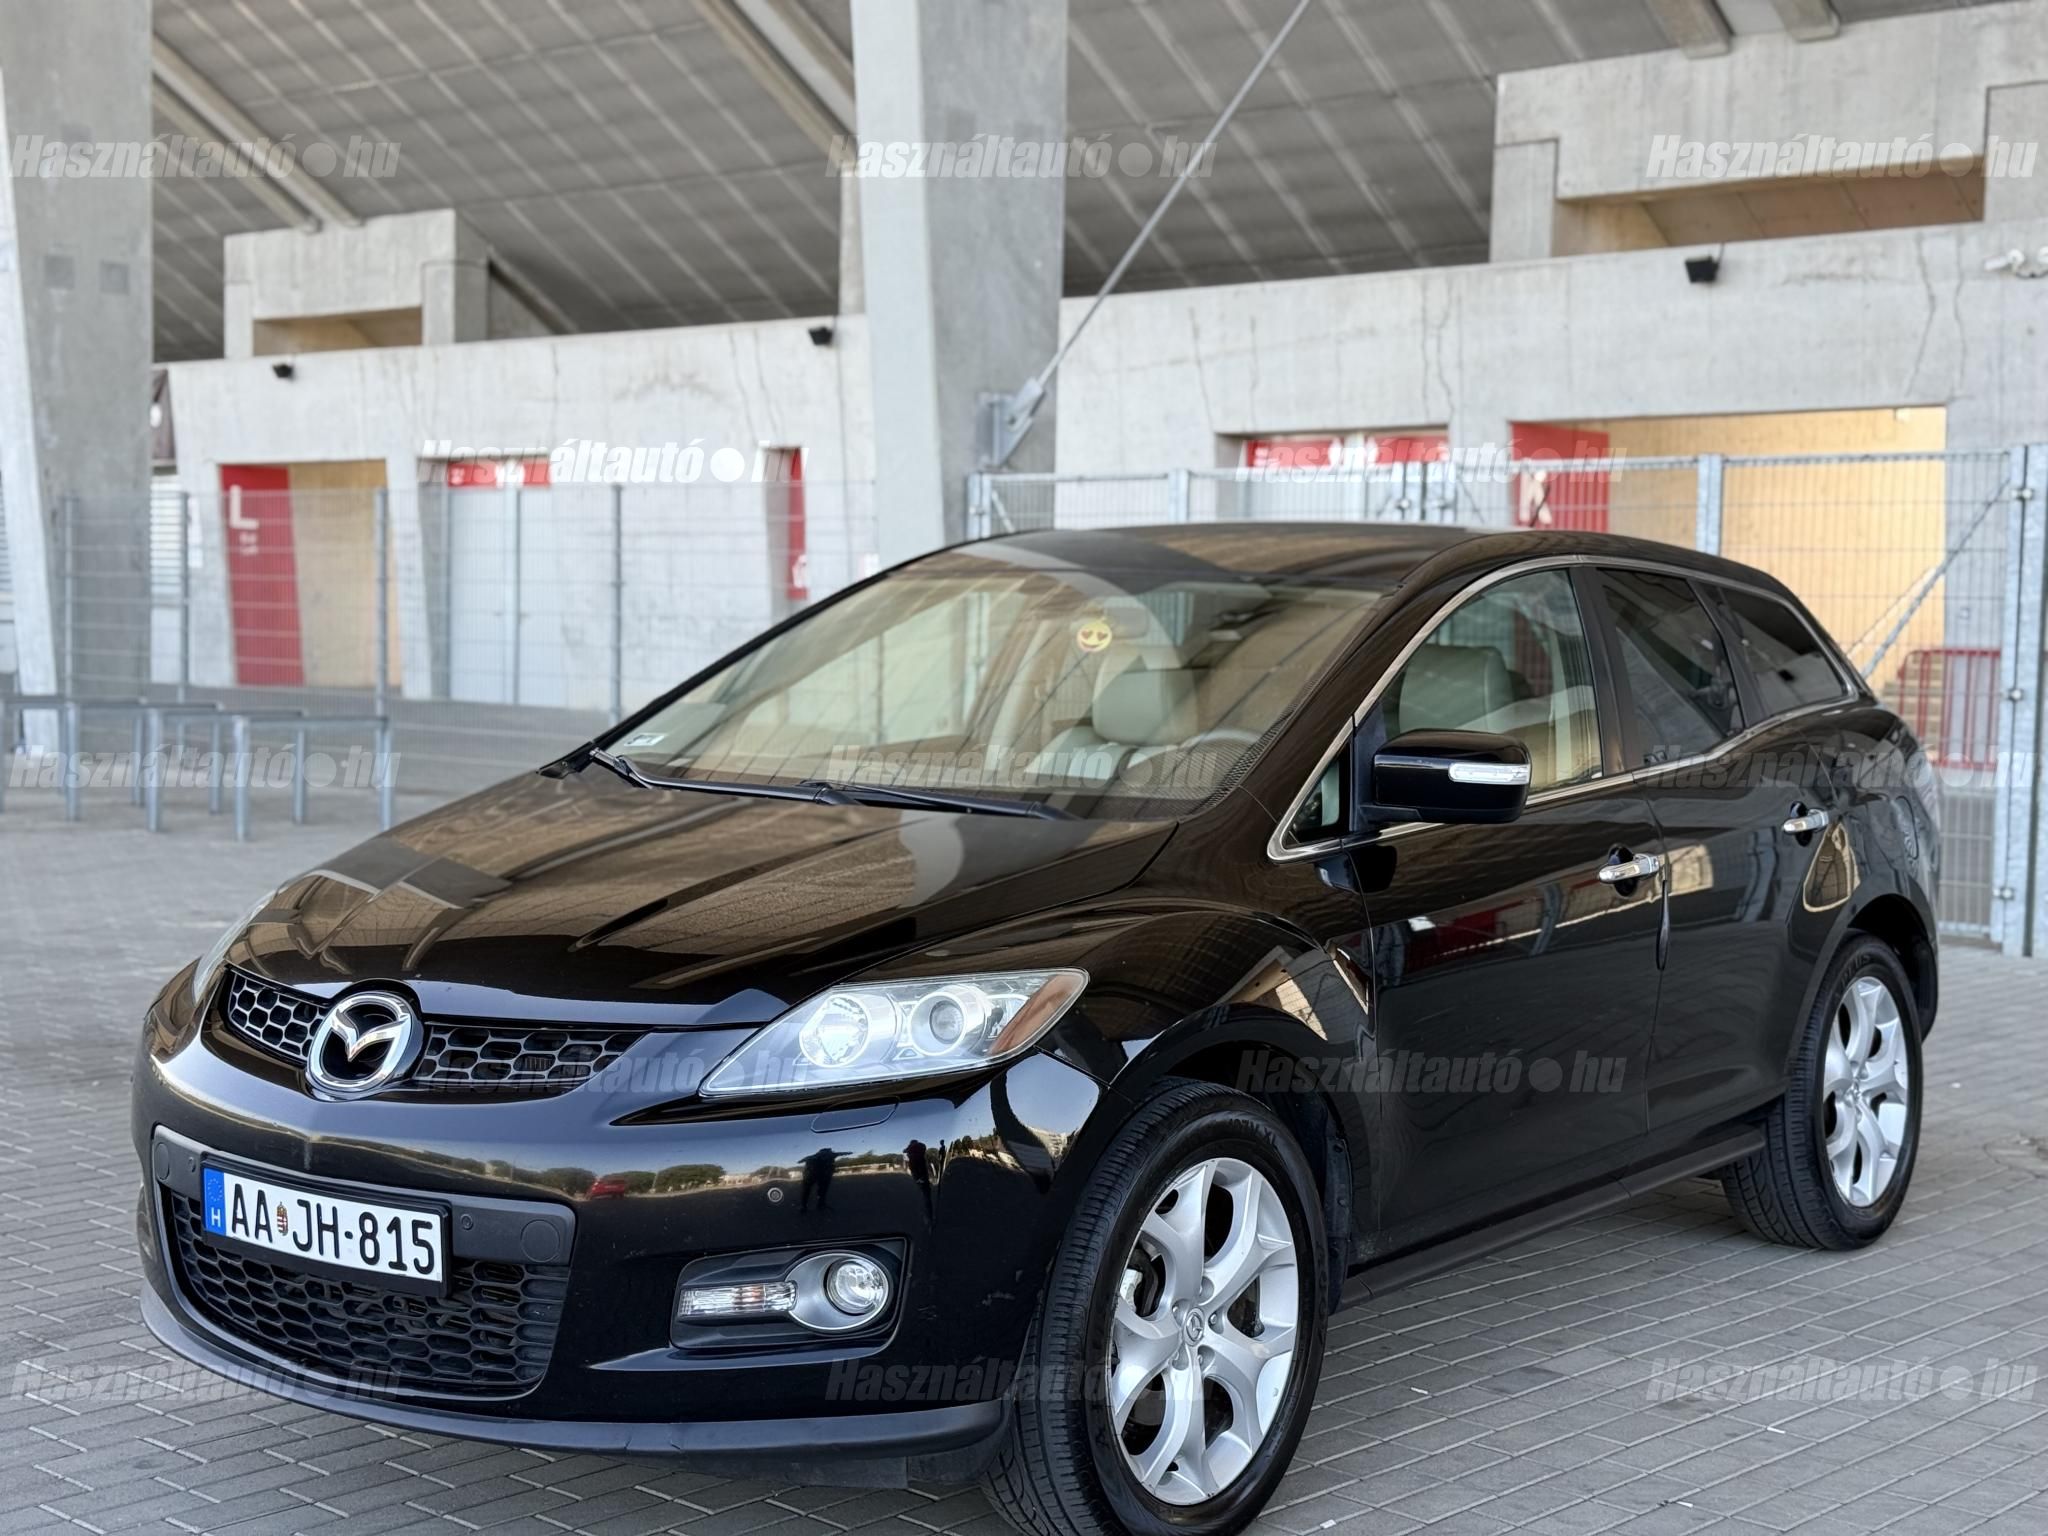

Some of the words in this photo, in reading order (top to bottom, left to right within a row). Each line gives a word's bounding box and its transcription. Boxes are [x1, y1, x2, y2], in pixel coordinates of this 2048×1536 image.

[228, 484, 260, 530] L
[210, 1207, 222, 1228] H
[231, 1183, 273, 1243] AA
